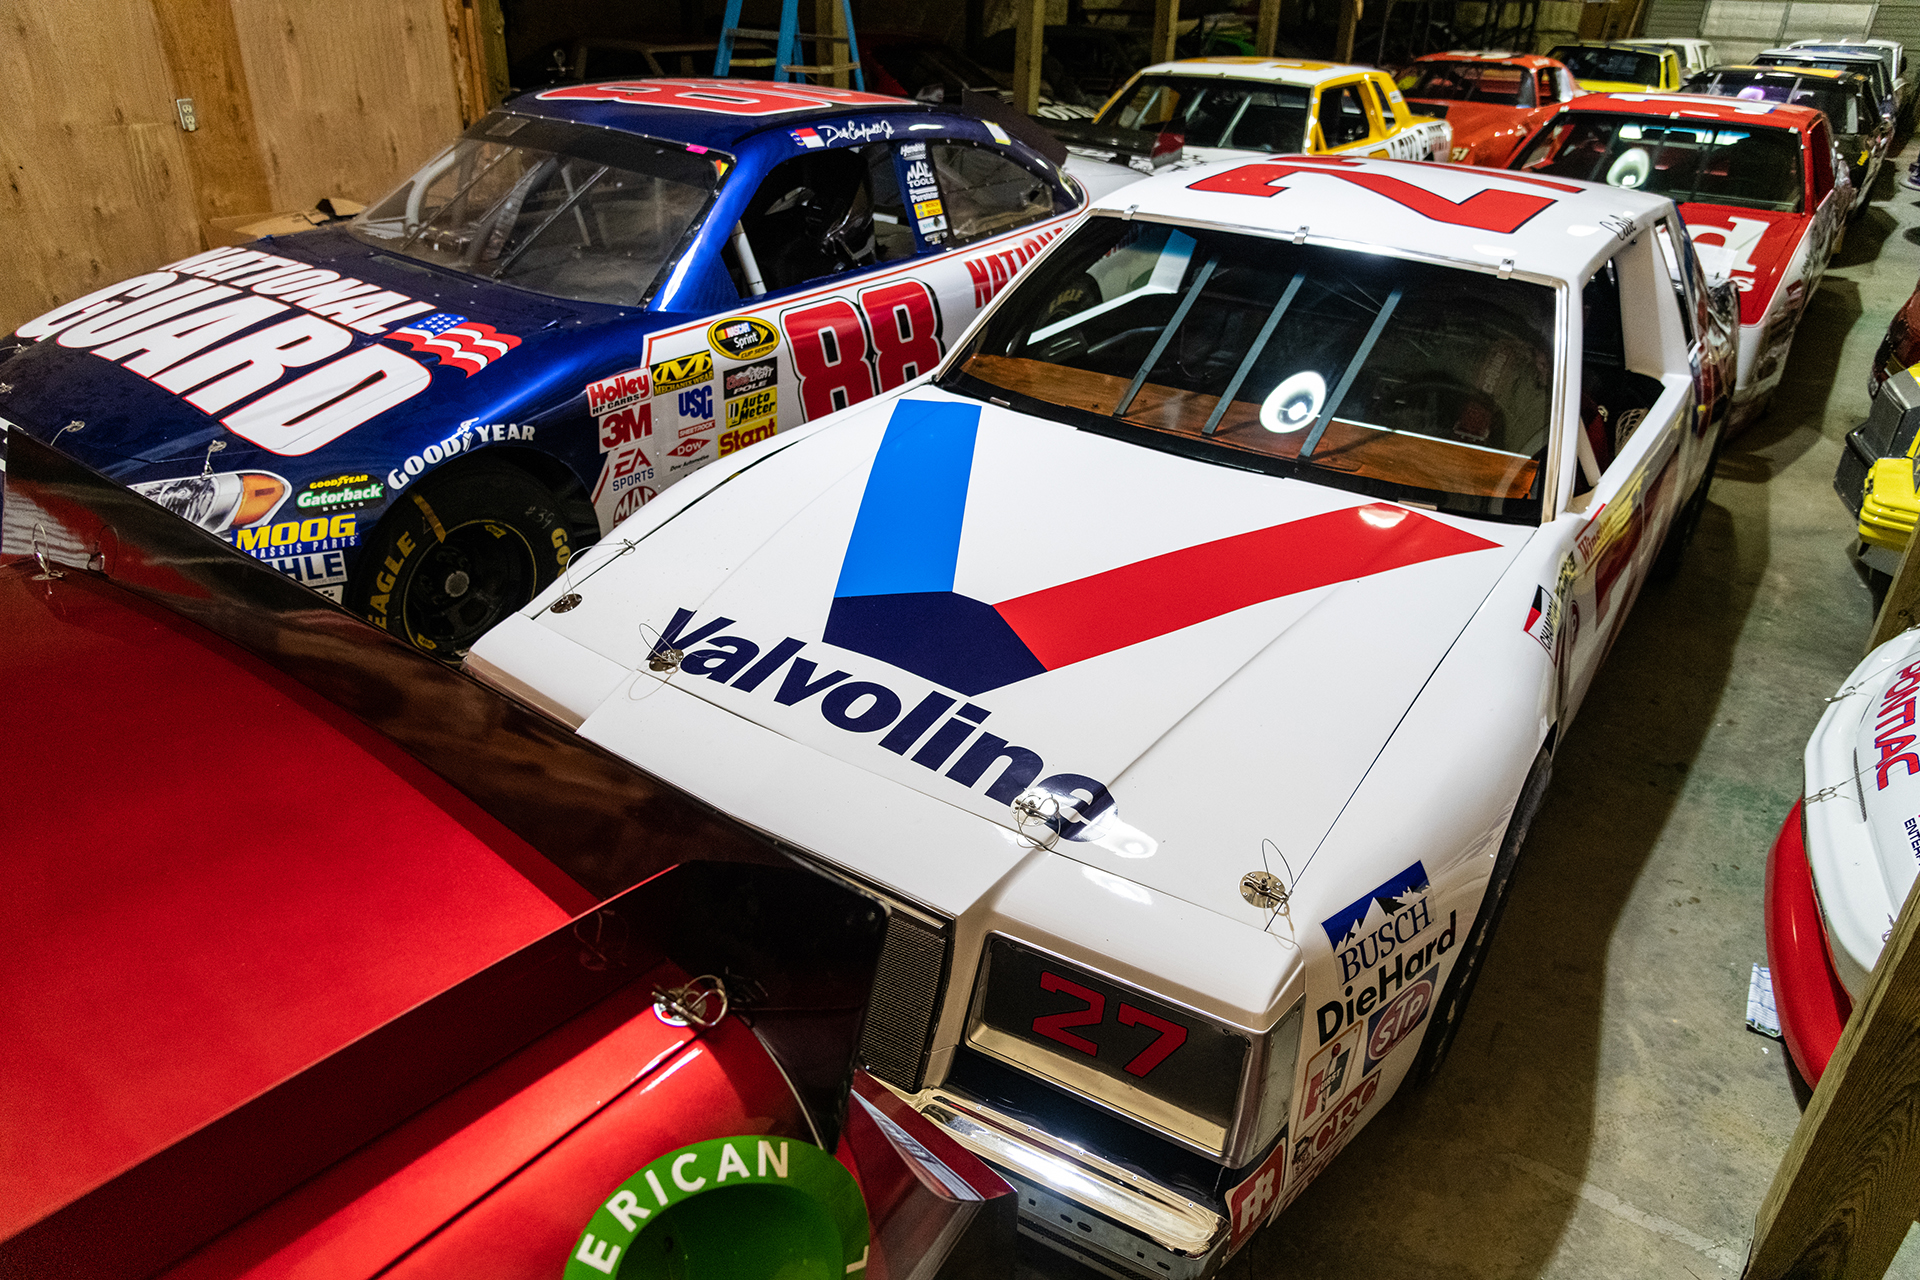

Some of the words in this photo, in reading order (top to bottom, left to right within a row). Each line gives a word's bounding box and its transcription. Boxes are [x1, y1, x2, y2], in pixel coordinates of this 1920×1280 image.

[907, 161, 934, 182] MAC
[907, 177, 936, 188] TOOLS
[156, 245, 438, 336] NATIONAL
[733, 332, 759, 350] Sprint
[740, 349, 754, 360] CUP
[753, 344, 775, 356] SERIES
[781, 276, 947, 424] 88
[15, 270, 432, 457] GUARD
[588, 372, 650, 408] Holley
[592, 403, 607, 415] HP
[607, 393, 640, 411] CARBS
[678, 384, 714, 420] USG
[733, 380, 768, 396] POLE
[741, 391, 771, 410] Auto
[602, 404, 653, 449] 3M
[740, 401, 776, 420] Meter
[720, 417, 776, 457] Stant
[612, 467, 655, 492] SPORTS
[613, 447, 652, 480] EA
[297, 484, 383, 508] Gatorback
[309, 474, 369, 490] GOODYEAR
[322, 501, 364, 512] BELTS
[236, 513, 356, 551] MOOG
[313, 536, 356, 552] PARTS
[244, 543, 303, 559] HASSIS
[551, 527, 571, 578] GO
[368, 530, 417, 630] EAGLE
[644, 606, 1119, 843] Valvoline
[1874, 659, 1920, 792] PONTIAC
[1338, 896, 1432, 986] BUSCH
[1316, 909, 1457, 1048] DieHard
[1031, 969, 1189, 1078] 27
[1375, 990, 1424, 1053] STP
[1313, 1067, 1342, 1098] HURST
[1312, 1069, 1380, 1158] CRC
